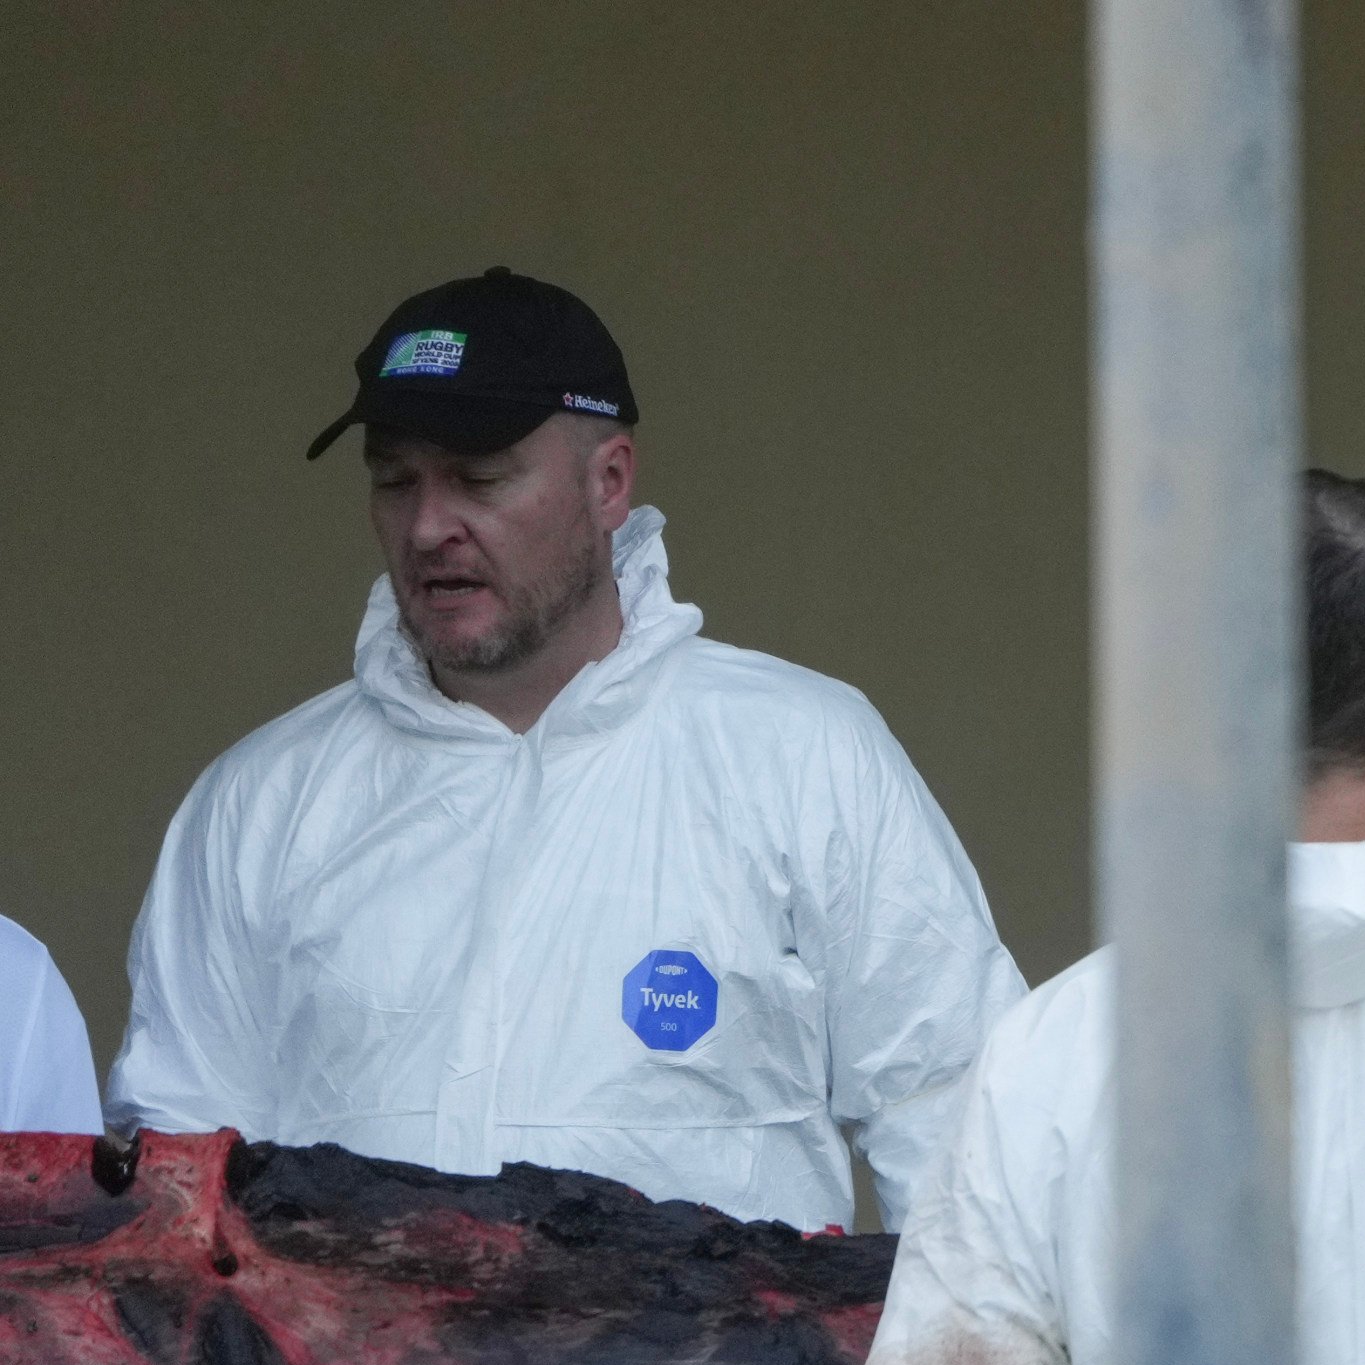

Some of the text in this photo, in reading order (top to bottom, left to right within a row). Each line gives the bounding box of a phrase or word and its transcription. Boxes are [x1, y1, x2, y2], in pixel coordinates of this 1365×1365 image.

[415, 341, 465, 354] RUGBY
[640, 988, 700, 1012] Tyvek
[660, 1022, 677, 1031] 500
